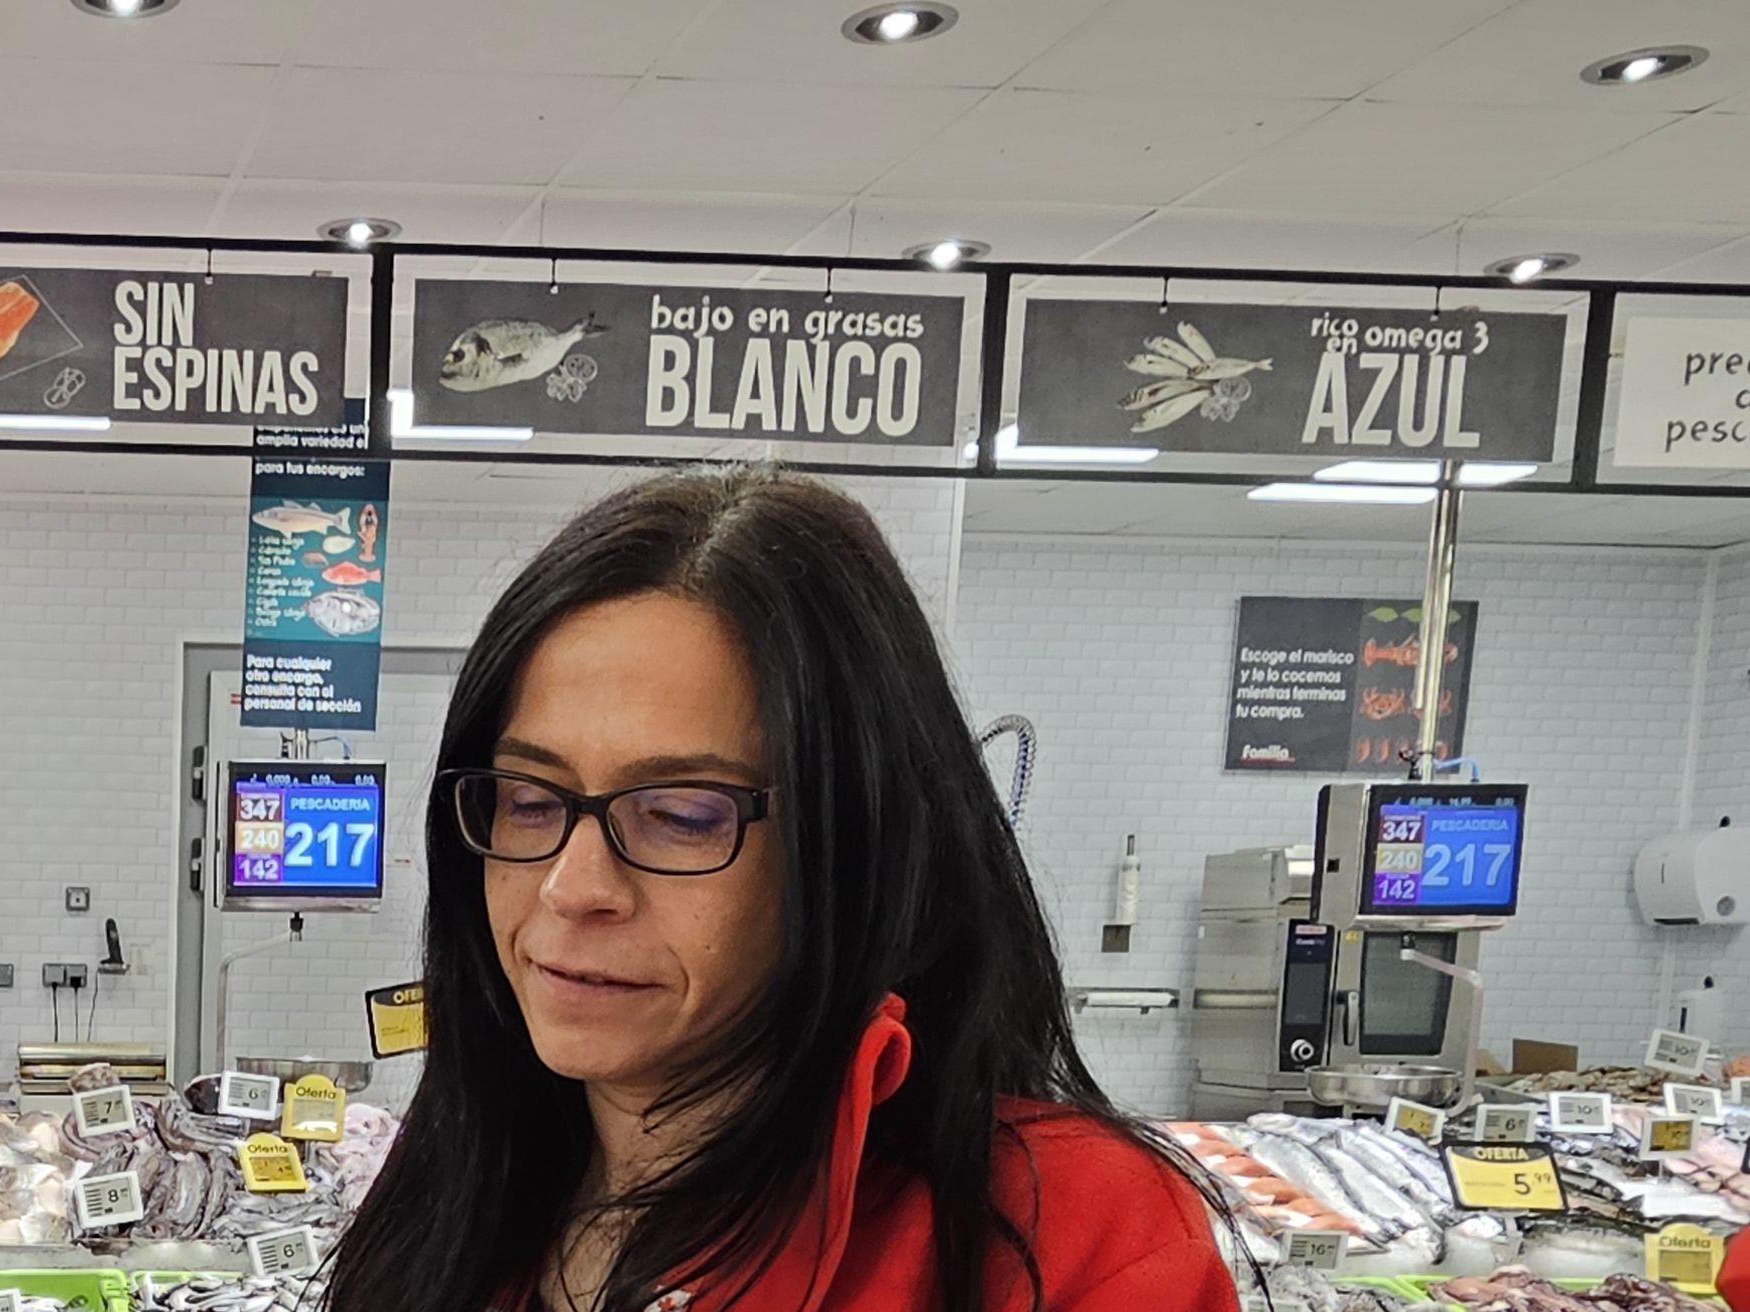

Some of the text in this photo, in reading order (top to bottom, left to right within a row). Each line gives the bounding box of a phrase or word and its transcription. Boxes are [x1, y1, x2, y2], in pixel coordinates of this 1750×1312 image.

[113, 280, 195, 347] SIN
[651, 294, 925, 343] bajo en grasas
[1310, 311, 1489, 357] rico en omega 3
[112, 346, 319, 416] ESPINAS
[645, 334, 923, 437] BLANCO
[1301, 351, 1481, 448] AZUL
[256, 434, 299, 448] amplia
[301, 436, 354, 449] variedad
[1664, 420, 1750, 454] pesc
[255, 462, 284, 475] para
[246, 654, 332, 672] Para cualquier
[1241, 647, 1355, 666] Escoge el marisco
[245, 669, 270, 683] otro
[1240, 669, 1250, 684] y
[1266, 667, 1280, 682] lo
[1281, 670, 1341, 684] cocemos
[245, 684, 296, 697] consulta
[297, 685, 320, 698] con
[1237, 684, 1347, 702] mientras terminas
[243, 697, 296, 712] personal
[297, 698, 314, 711] de
[1236, 703, 1304, 721] tu compra.
[239, 797, 371, 821] 347 PESCADERIA
[1381, 818, 1510, 842] 347 PESCADERIA
[241, 821, 376, 868] 240 217
[238, 859, 279, 880] 142
[1379, 843, 1513, 887] 240 217
[1377, 879, 1417, 900] 142
[295, 1086, 337, 1101] Oferta
